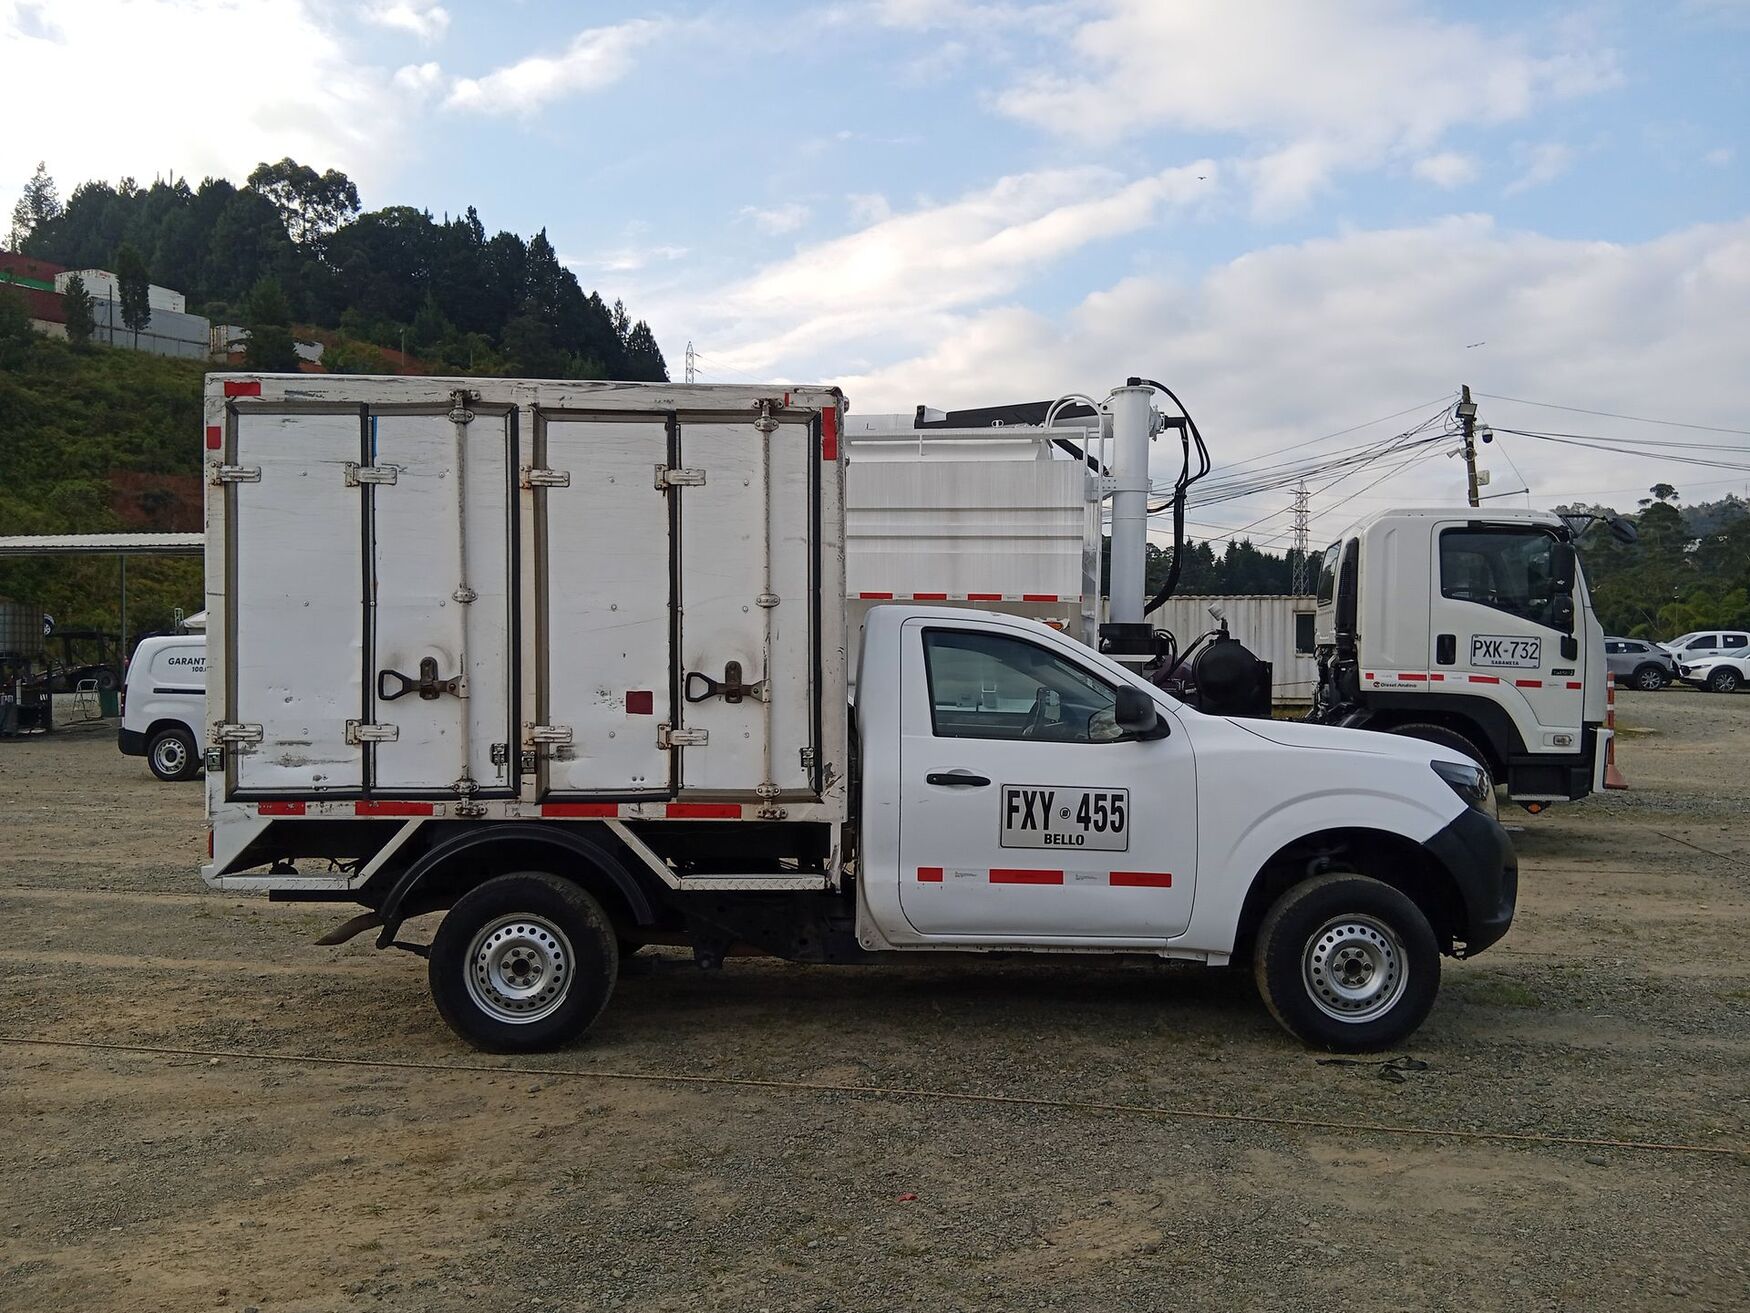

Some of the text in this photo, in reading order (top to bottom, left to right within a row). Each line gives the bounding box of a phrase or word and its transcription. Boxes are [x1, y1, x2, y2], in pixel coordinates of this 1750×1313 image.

[1473, 639, 1539, 660] PXK-732
[168, 657, 206, 665] GARANT
[1006, 790, 1125, 833] FXY 455
[1044, 833, 1085, 846] BELLO
